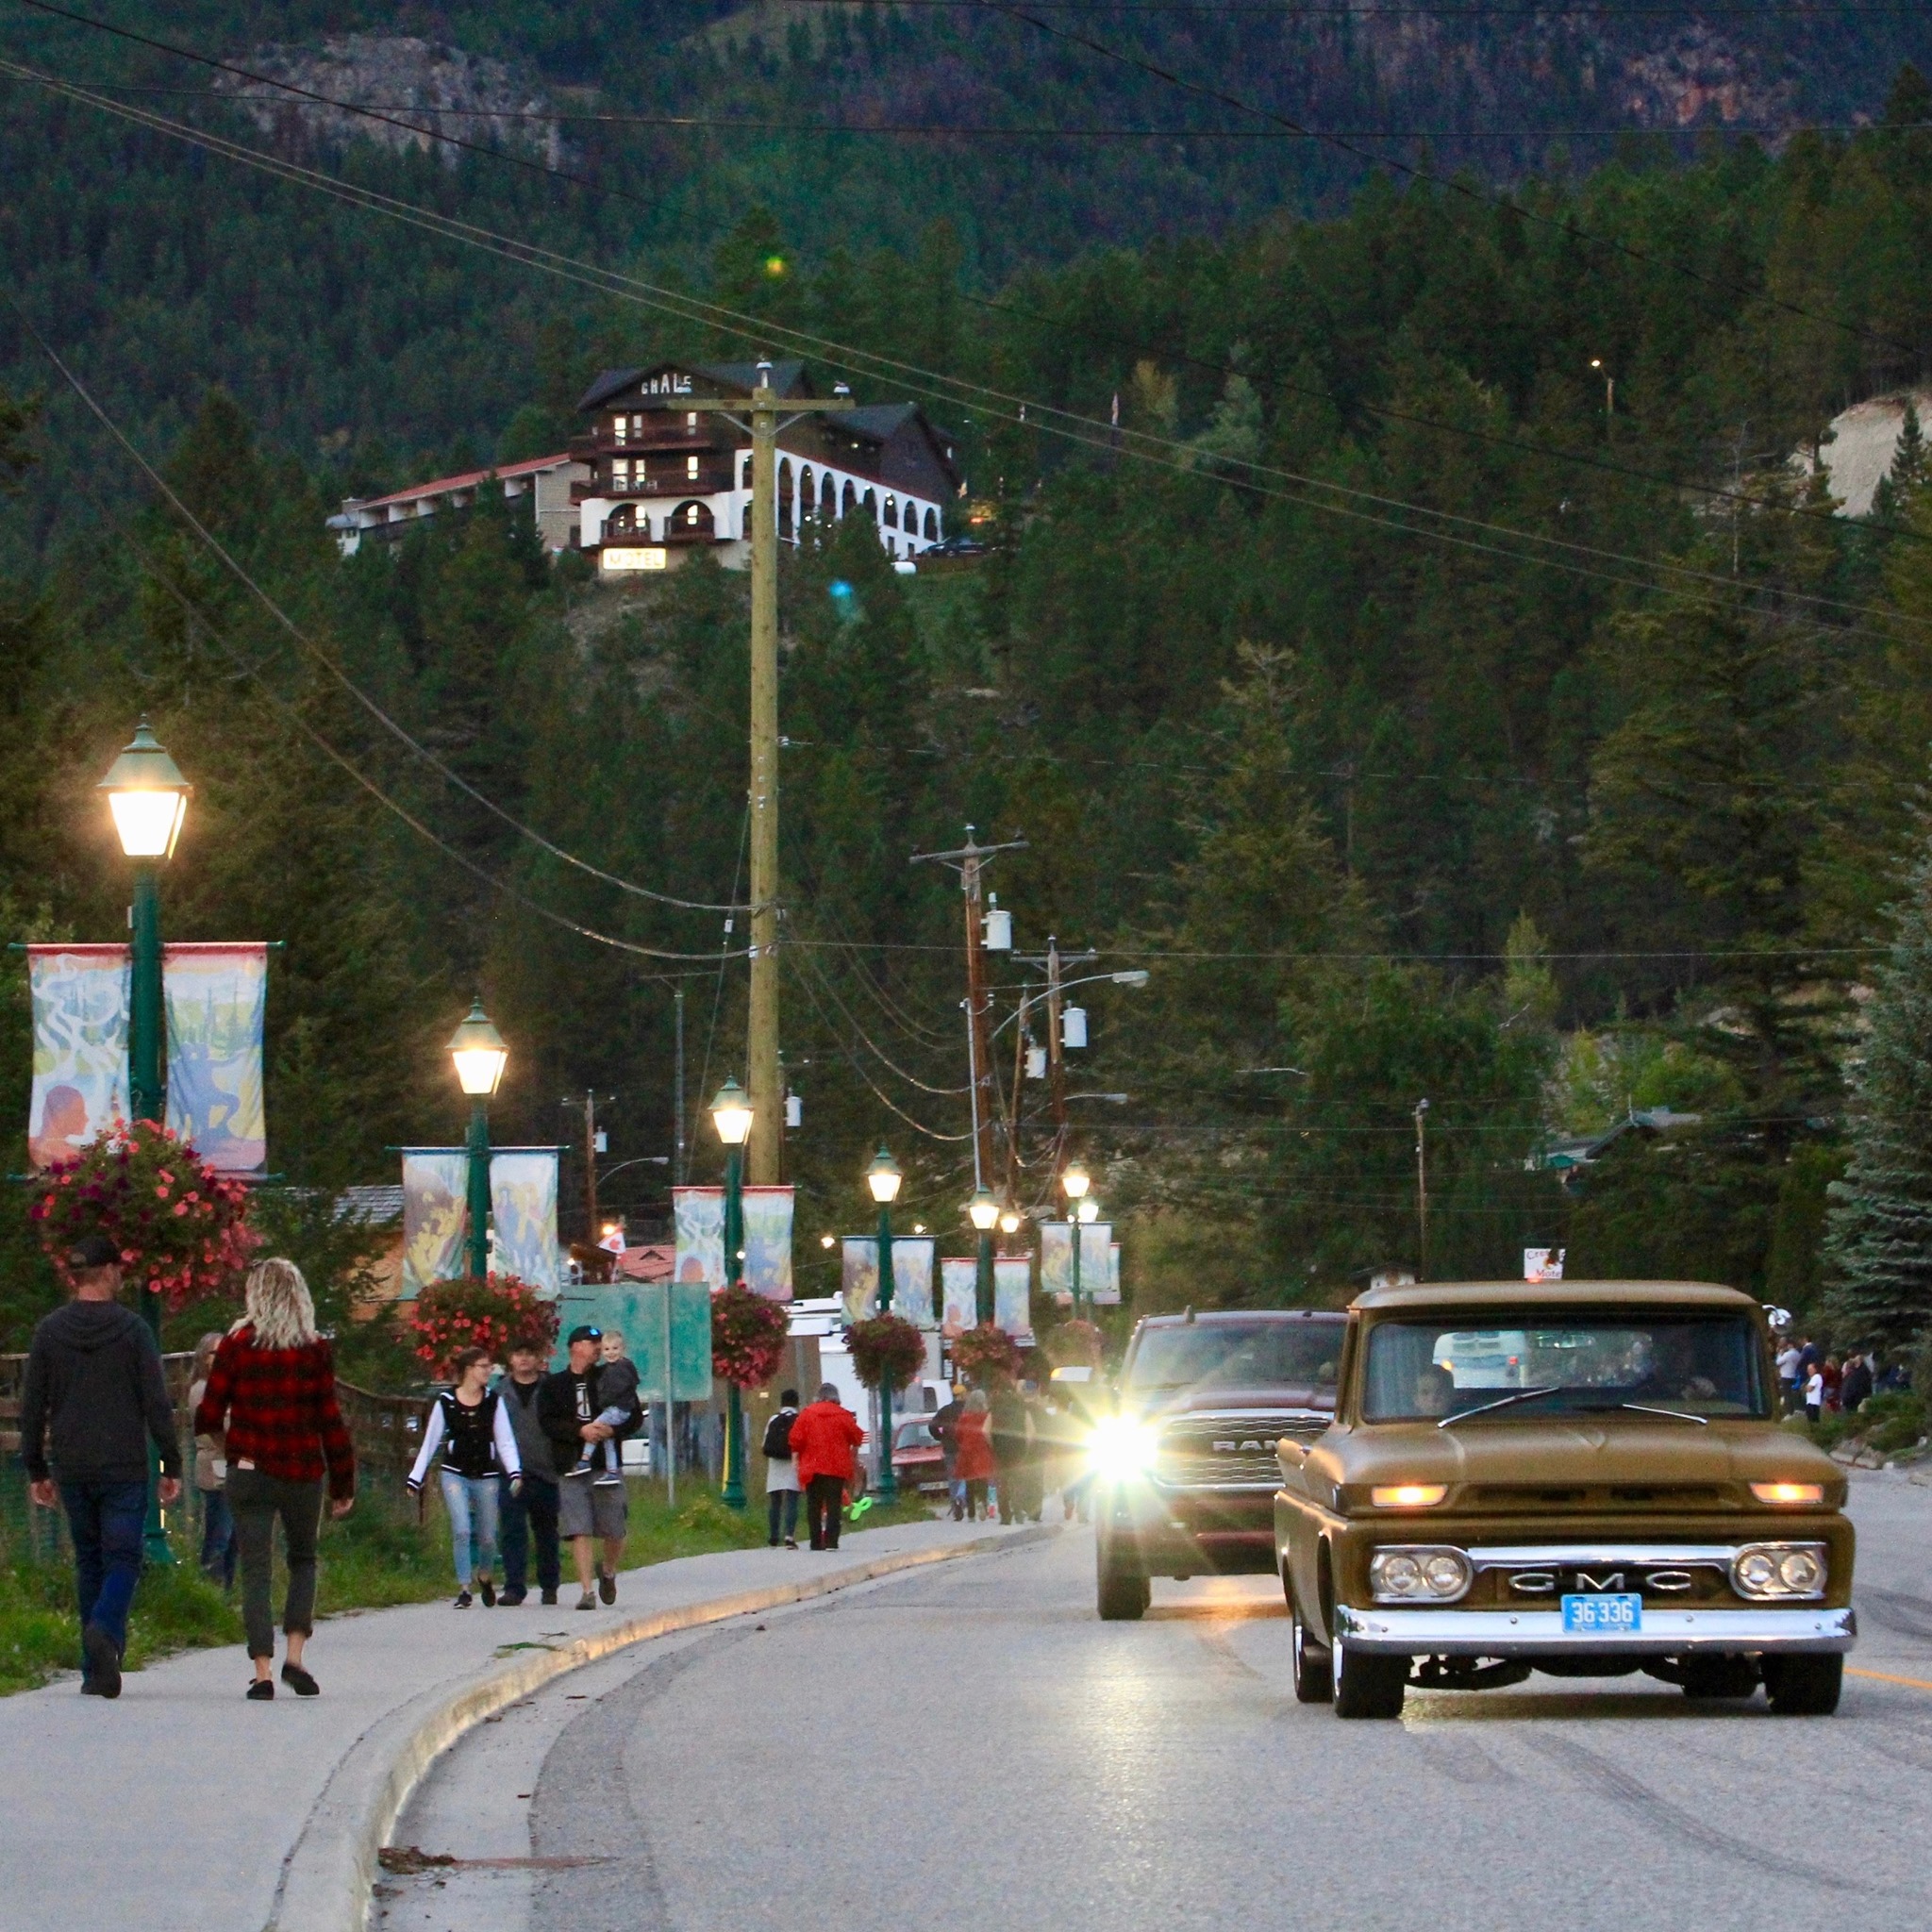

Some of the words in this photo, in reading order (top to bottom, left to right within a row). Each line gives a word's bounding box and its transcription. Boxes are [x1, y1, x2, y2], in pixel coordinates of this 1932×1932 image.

[608, 551, 662, 566] MOTEL
[1537, 1269, 1561, 1278] Mote
[1509, 1571, 1691, 1592] GMC
